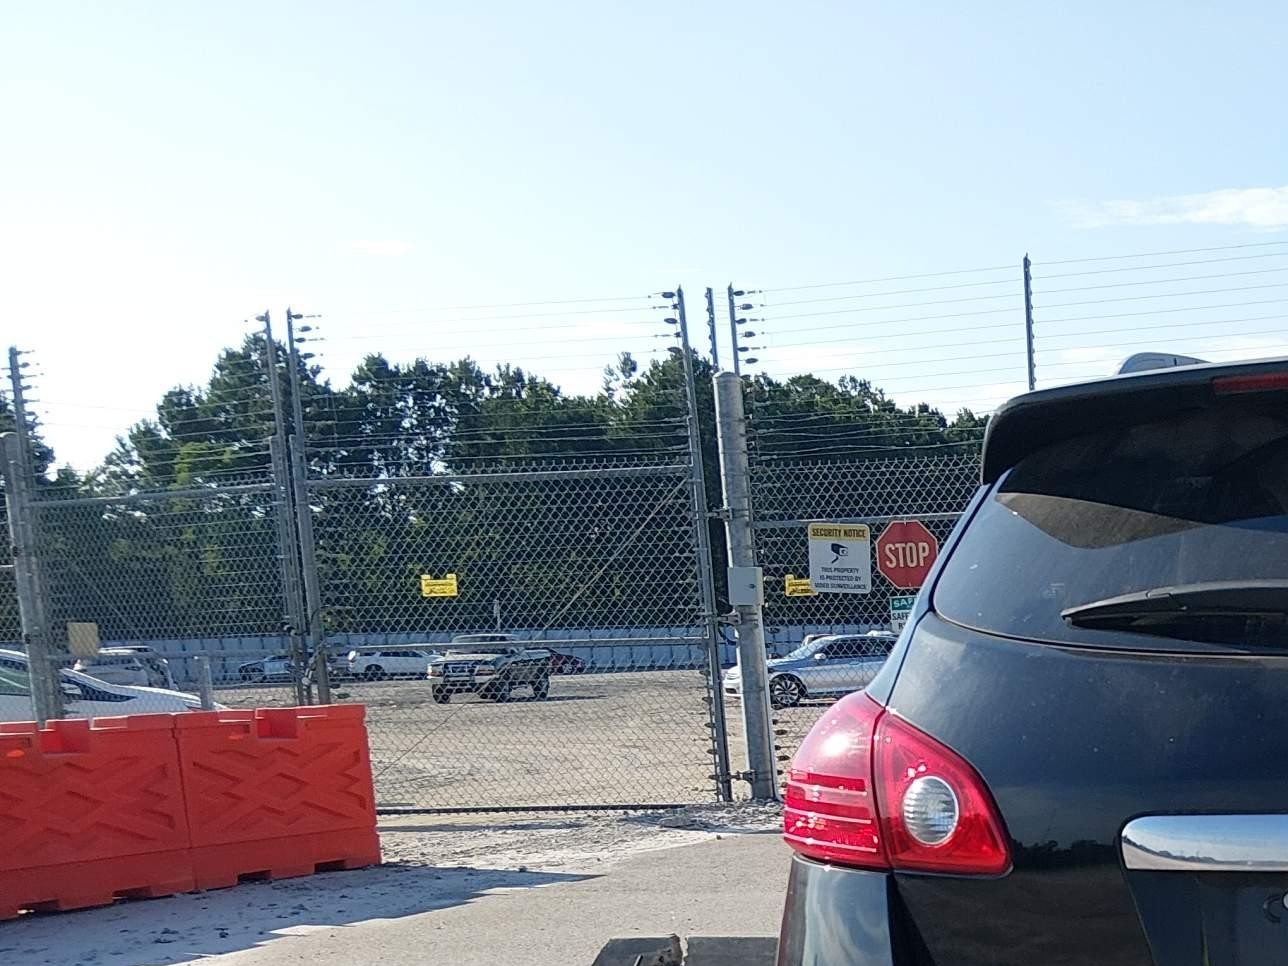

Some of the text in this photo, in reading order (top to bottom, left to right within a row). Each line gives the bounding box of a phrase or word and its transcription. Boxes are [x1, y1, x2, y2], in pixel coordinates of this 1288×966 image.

[811, 527, 867, 538] SECURITY NOTICE
[884, 542, 930, 569] STOP
